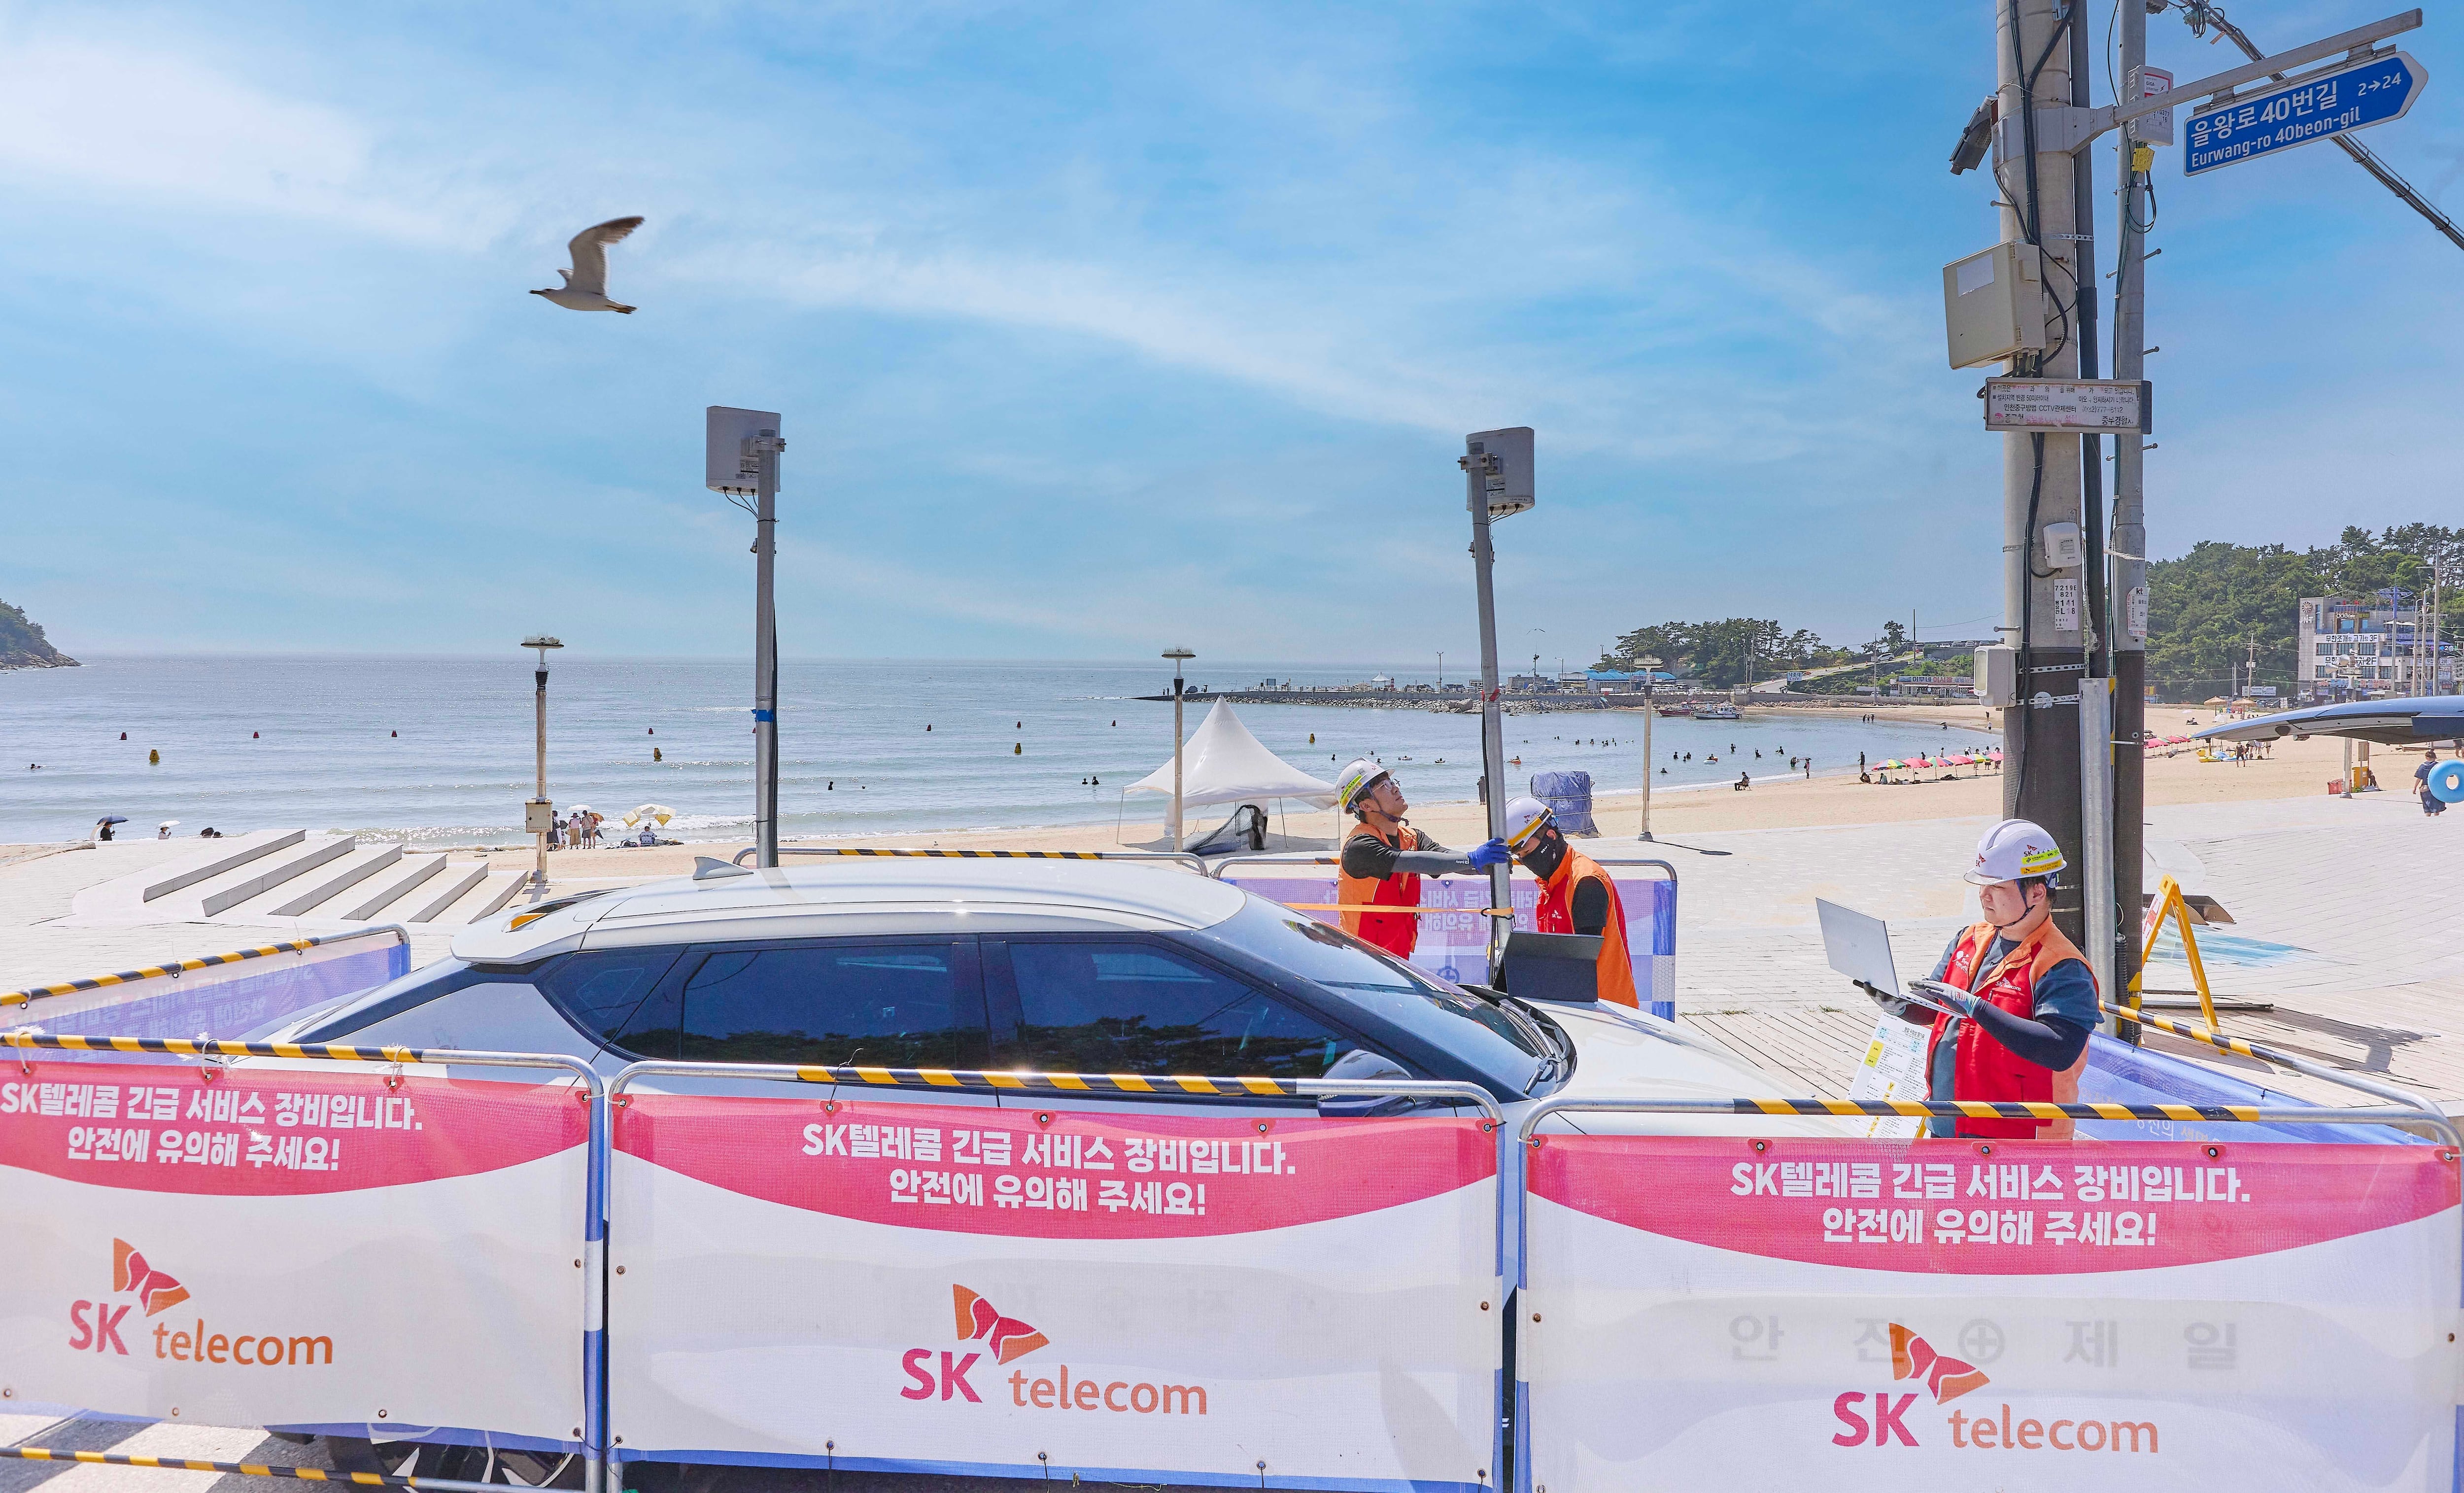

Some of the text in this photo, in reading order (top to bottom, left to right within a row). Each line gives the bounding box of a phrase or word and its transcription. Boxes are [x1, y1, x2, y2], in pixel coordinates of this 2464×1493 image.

[2191, 80, 2337, 148] 을왕로 40번길
[2191, 107, 2360, 168] Eurwang-ro 40beon-gil
[2365, 657, 2377, 665] 2F
[1, 1082, 422, 1130] SK텔레콤 긴급 서비스 장비입니다.
[68, 1126, 340, 1171] 안전에 유의해 주세요!
[801, 1123, 1296, 1175] SK텔레콤 긴급 서비스 장비입니다.
[890, 1169, 1205, 1215] 안전에 유의해 주세요!
[1730, 1162, 2250, 1203] SK텔레콤 긴급 서비스 장비입니다.
[1823, 1208, 2156, 1246] 안전에 유의해 주세요!
[68, 1299, 333, 1366] SK telecom
[900, 1348, 1207, 1415] SK telecom
[1832, 1391, 2158, 1454] SK telecom
